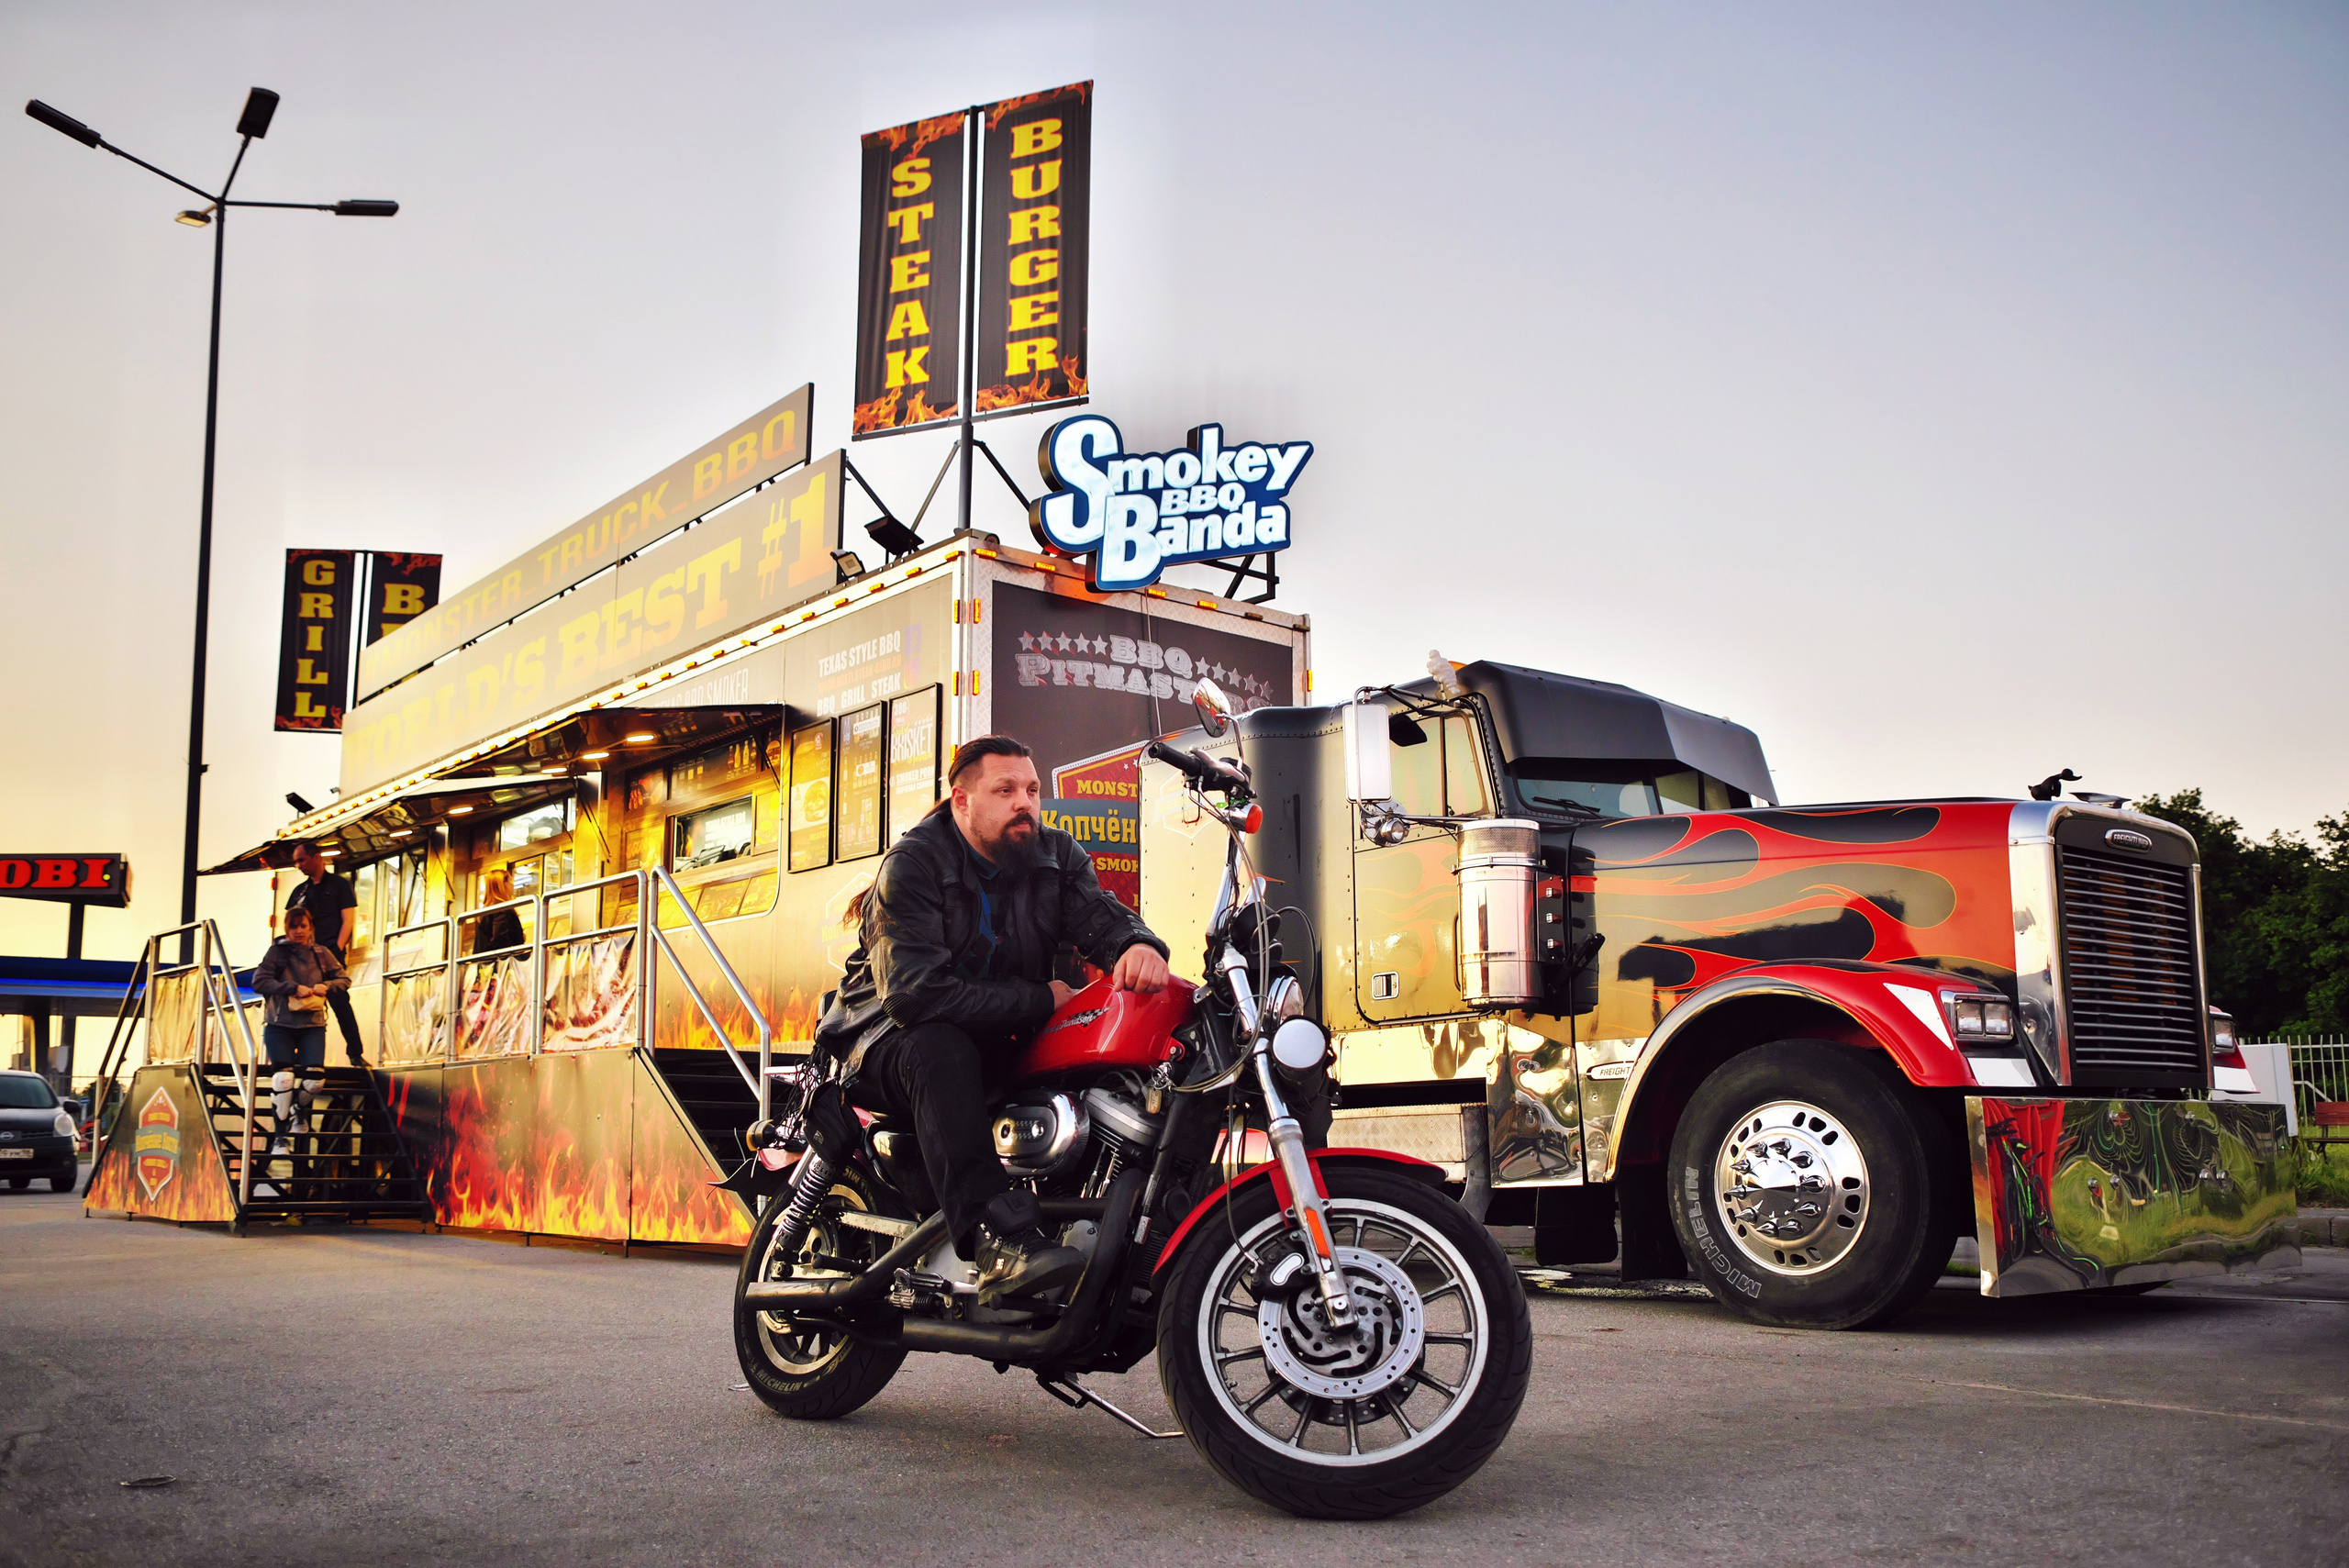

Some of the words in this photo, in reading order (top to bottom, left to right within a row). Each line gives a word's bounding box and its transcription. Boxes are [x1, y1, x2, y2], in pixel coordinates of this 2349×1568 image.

[885, 156, 934, 390] STEAK
[1005, 117, 1063, 377] BURGER
[1044, 419, 1311, 539] Smokey
[1159, 485, 1247, 517] BBQ
[1101, 494, 1287, 583] Banda
[555, 536, 742, 693] BEST
[757, 471, 834, 600] #1
[294, 559, 336, 718] GRILL
[818, 650, 848, 678] TEXAS
[849, 639, 878, 668] STYLE
[879, 630, 901, 657] BBQ
[1109, 634, 1193, 679] BBQ
[707, 667, 750, 706] SMOKER
[890, 723, 934, 763] BRISKET
[0, 858, 113, 888] OBI
[1685, 1166, 1762, 1299] MICHELIN
[756, 1368, 803, 1392] MICHELIN
